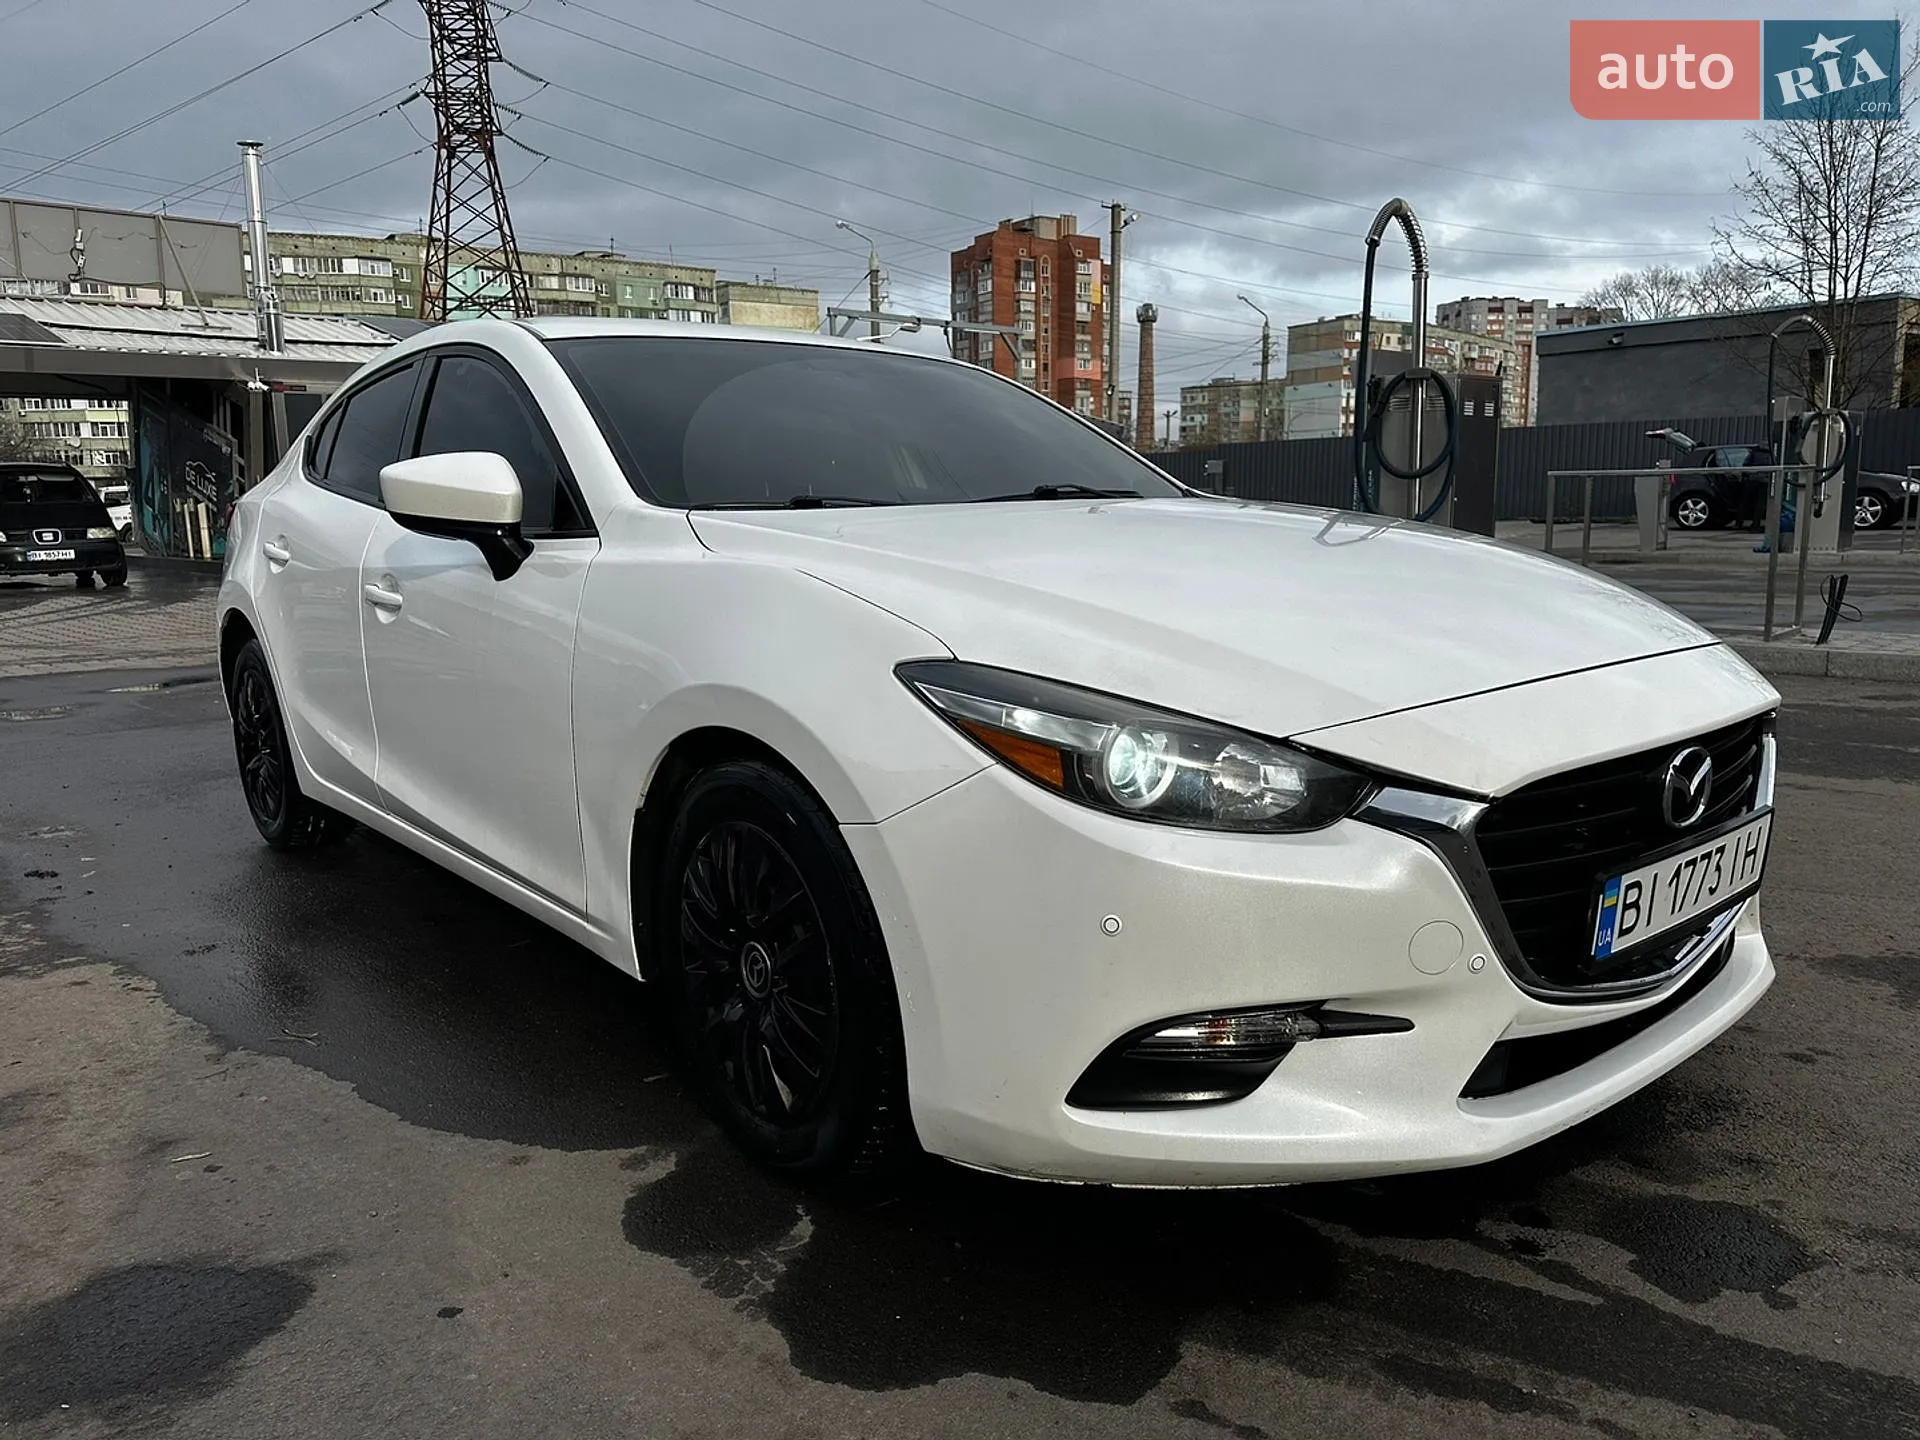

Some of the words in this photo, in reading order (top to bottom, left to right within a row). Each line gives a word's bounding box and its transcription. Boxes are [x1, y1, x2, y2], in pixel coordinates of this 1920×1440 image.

[196, 473, 217, 502] LUXE
[1617, 872, 1659, 938] BI
[1667, 843, 1727, 916] 1773
[1729, 826, 1762, 887] IH
[1597, 928, 1611, 946] UA
